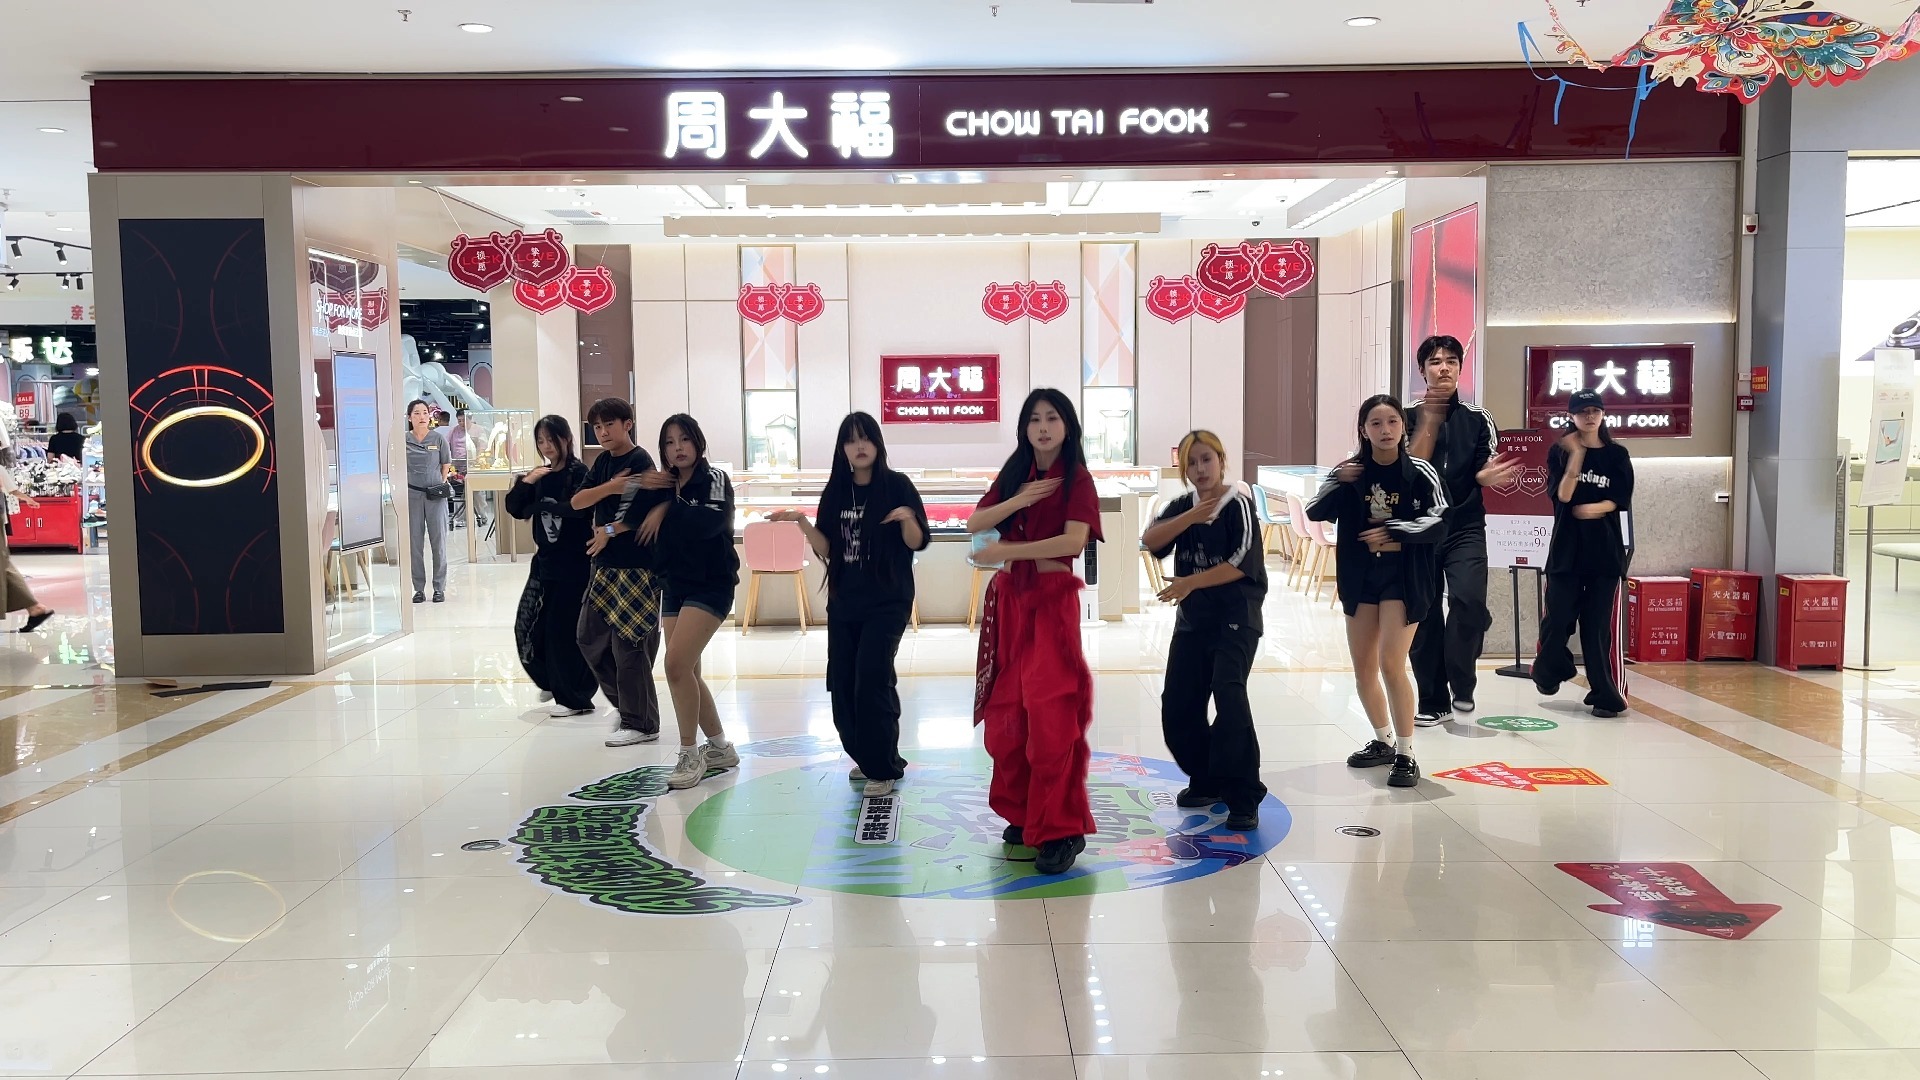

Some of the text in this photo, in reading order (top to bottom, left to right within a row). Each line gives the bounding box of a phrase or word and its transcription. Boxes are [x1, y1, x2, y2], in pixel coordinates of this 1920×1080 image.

[664, 91, 894, 159] 周大福
[946, 107, 1210, 137] CHOW TAI FOOK
[334, 303, 346, 318] FOR
[896, 366, 984, 393] 周大福
[1549, 359, 1672, 396] 周大福
[19, 408, 30, 418] 89
[897, 405, 984, 416] CHOW TAI FOOK
[1627, 414, 1670, 428] FOOK
[1648, 597, 1683, 607] 灭火器箱
[1712, 590, 1750, 601] 灭火器箱
[1802, 597, 1839, 607] 灭火器箱
